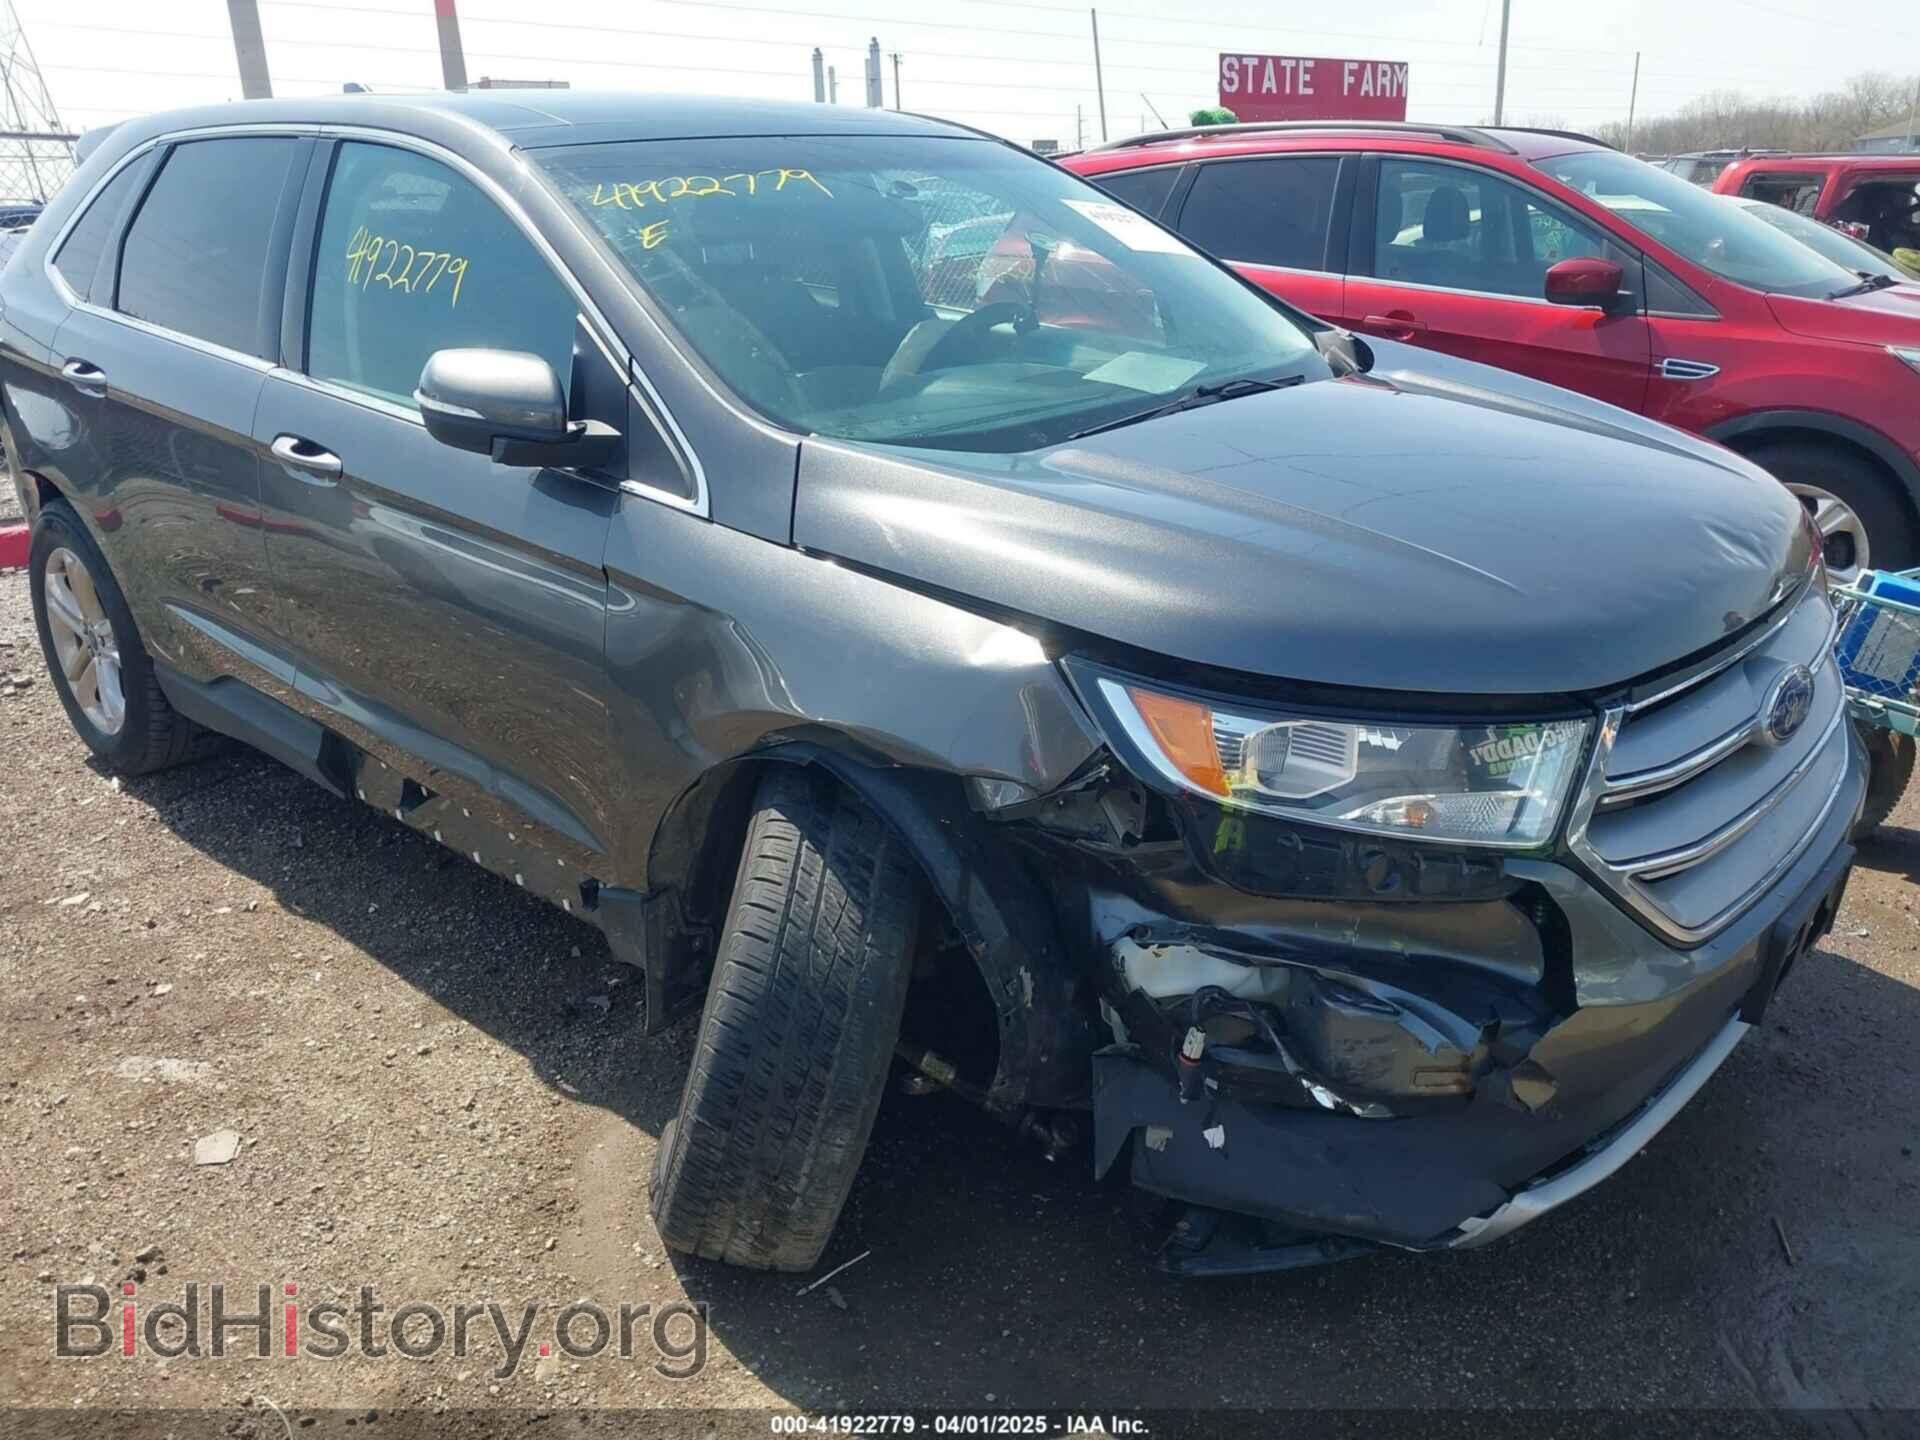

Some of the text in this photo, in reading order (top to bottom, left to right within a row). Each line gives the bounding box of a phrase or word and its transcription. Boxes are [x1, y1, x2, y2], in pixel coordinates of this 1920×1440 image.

[1221, 56, 1407, 97] STATE FARM
[591, 169, 834, 210] 41922779
[639, 219, 669, 249] E
[346, 225, 468, 309] 41922779
